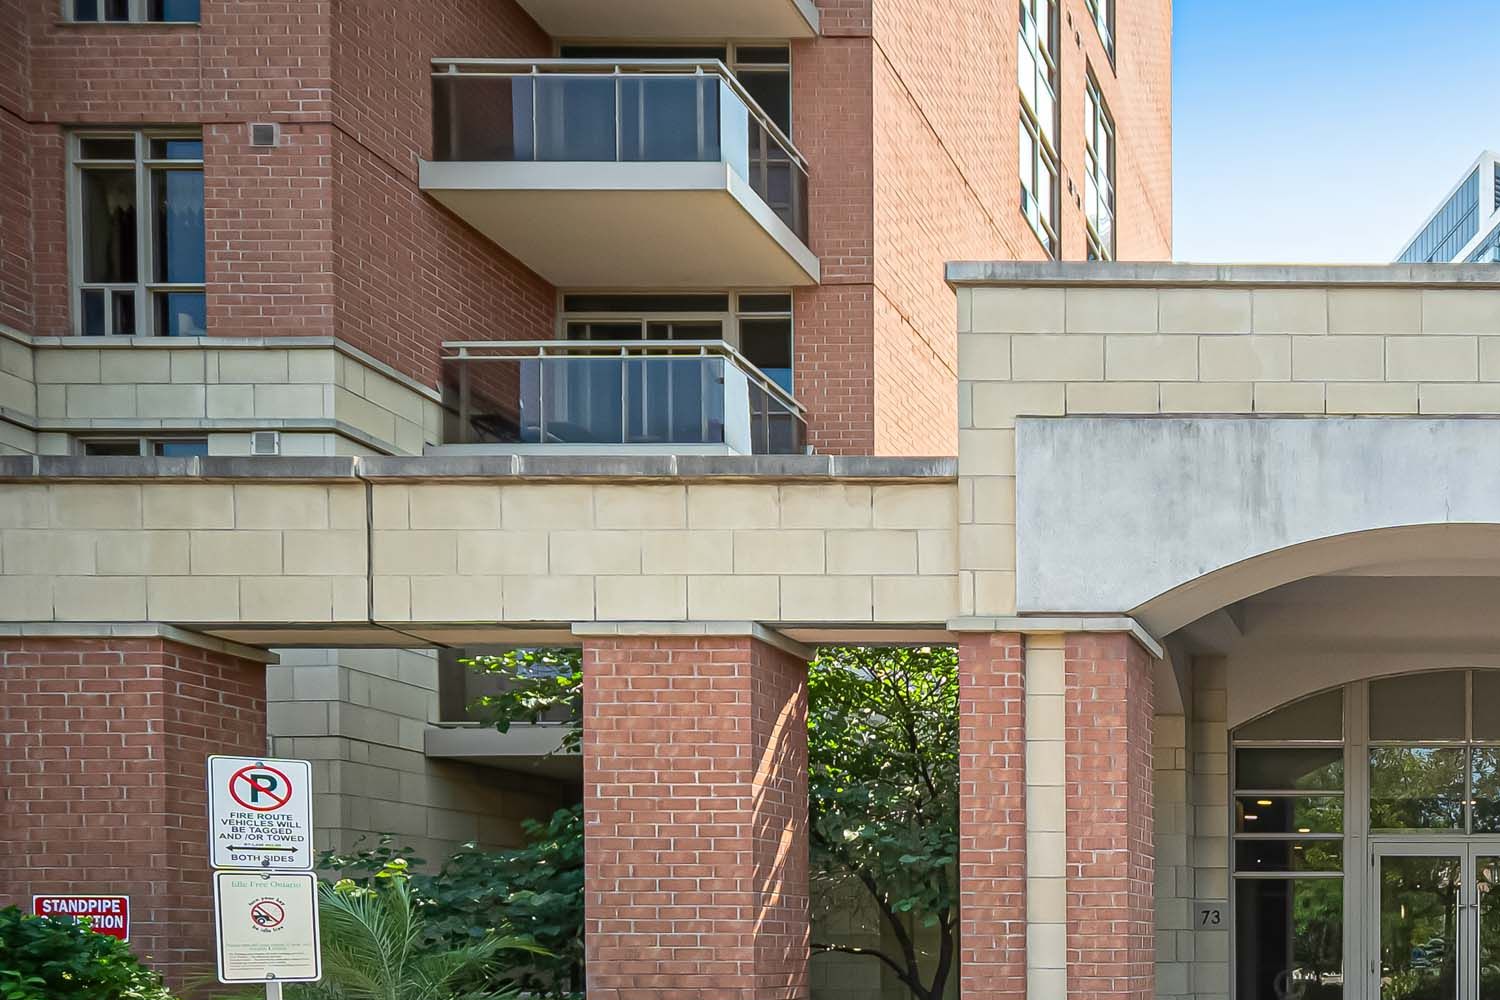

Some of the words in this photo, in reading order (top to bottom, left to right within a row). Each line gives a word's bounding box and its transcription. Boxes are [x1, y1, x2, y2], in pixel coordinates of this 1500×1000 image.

[221, 818, 274, 827] VEHICLES
[276, 821, 302, 829] WILL
[248, 826, 292, 834] TAGGED
[266, 834, 305, 842] TOWED
[263, 854, 295, 862] SIDES
[42, 899, 121, 913] STANDPIPE
[1200, 910, 1221, 925] 73
